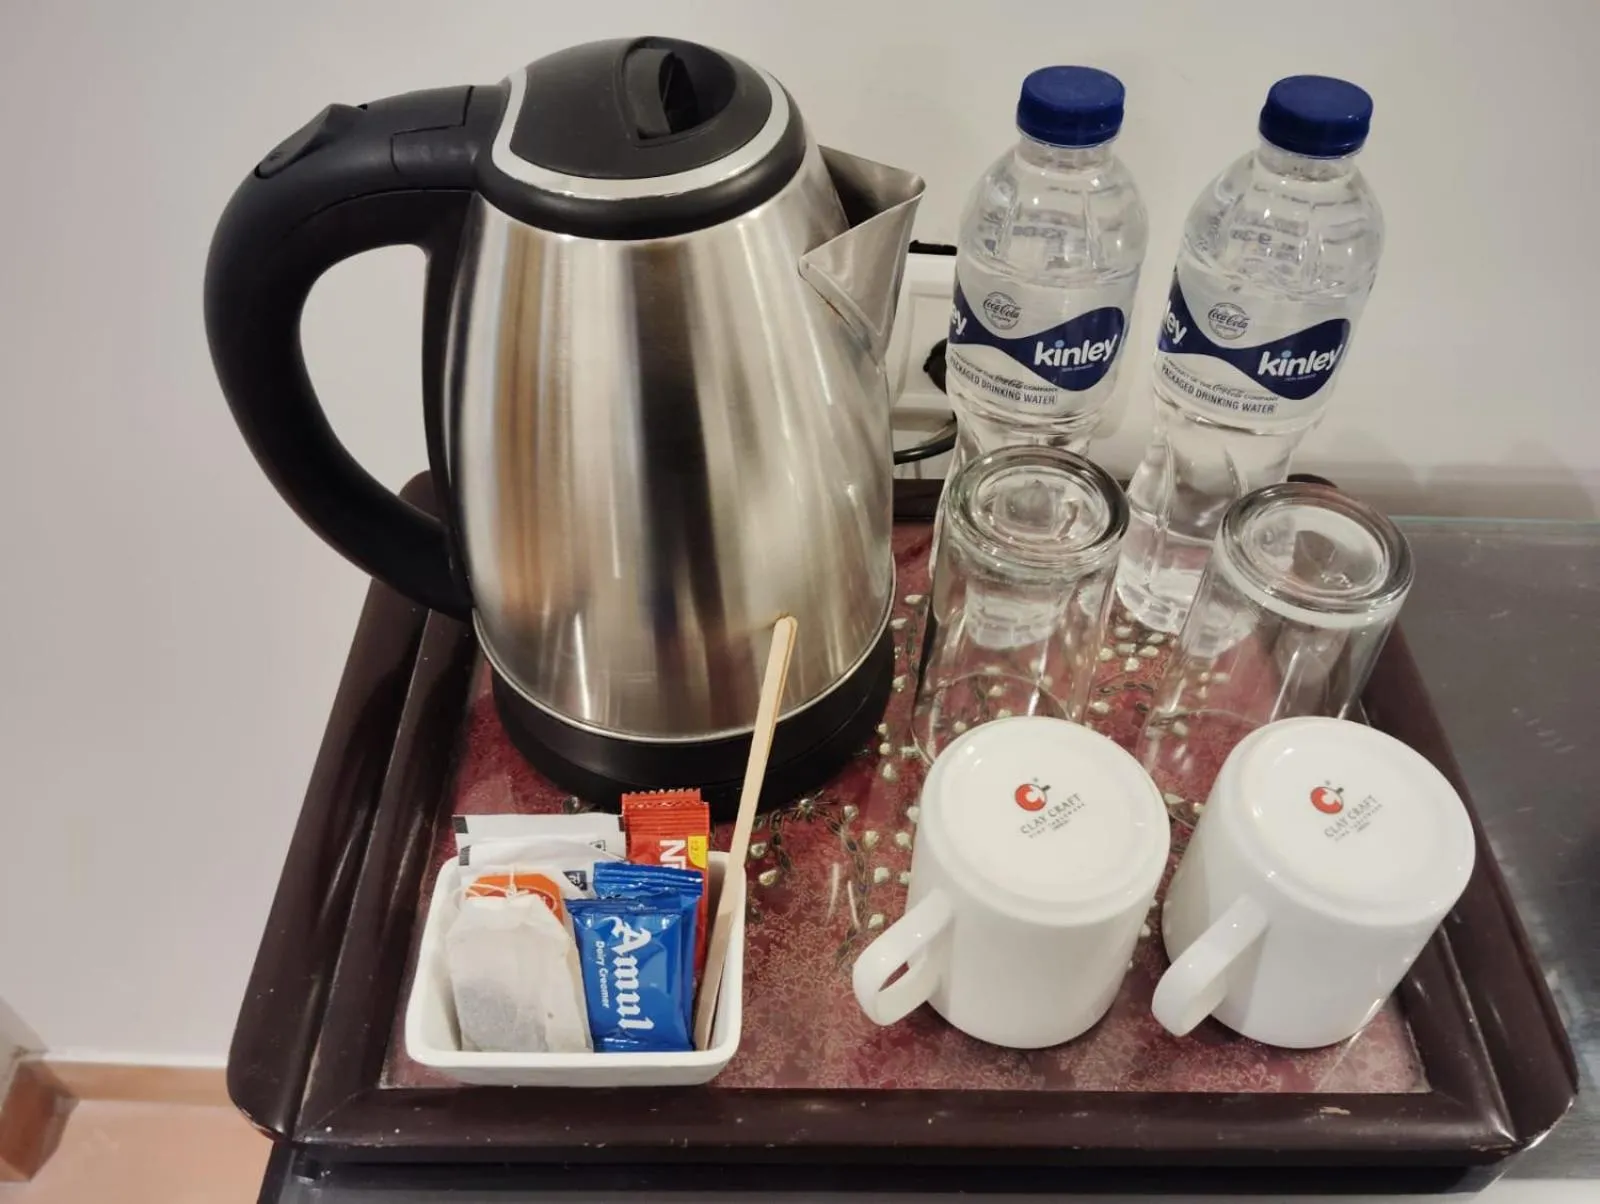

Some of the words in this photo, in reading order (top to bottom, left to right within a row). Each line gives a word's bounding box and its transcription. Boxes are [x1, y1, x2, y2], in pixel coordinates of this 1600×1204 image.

[1033, 334, 1118, 367] kinley
[1257, 344, 1343, 377] kinley
[981, 379, 1021, 402] DRINKING
[1023, 392, 1056, 406] WATER
[1161, 363, 1195, 395] PACKAGED
[1195, 387, 1240, 411] DRINKING
[1241, 402, 1276, 415] WATER
[1020, 815, 1047, 834] CLAY
[1047, 793, 1081, 818] CRAFT
[595, 940, 608, 966] Dairy
[599, 967, 610, 1009] Creamer
[600, 916, 655, 1030] Amul
